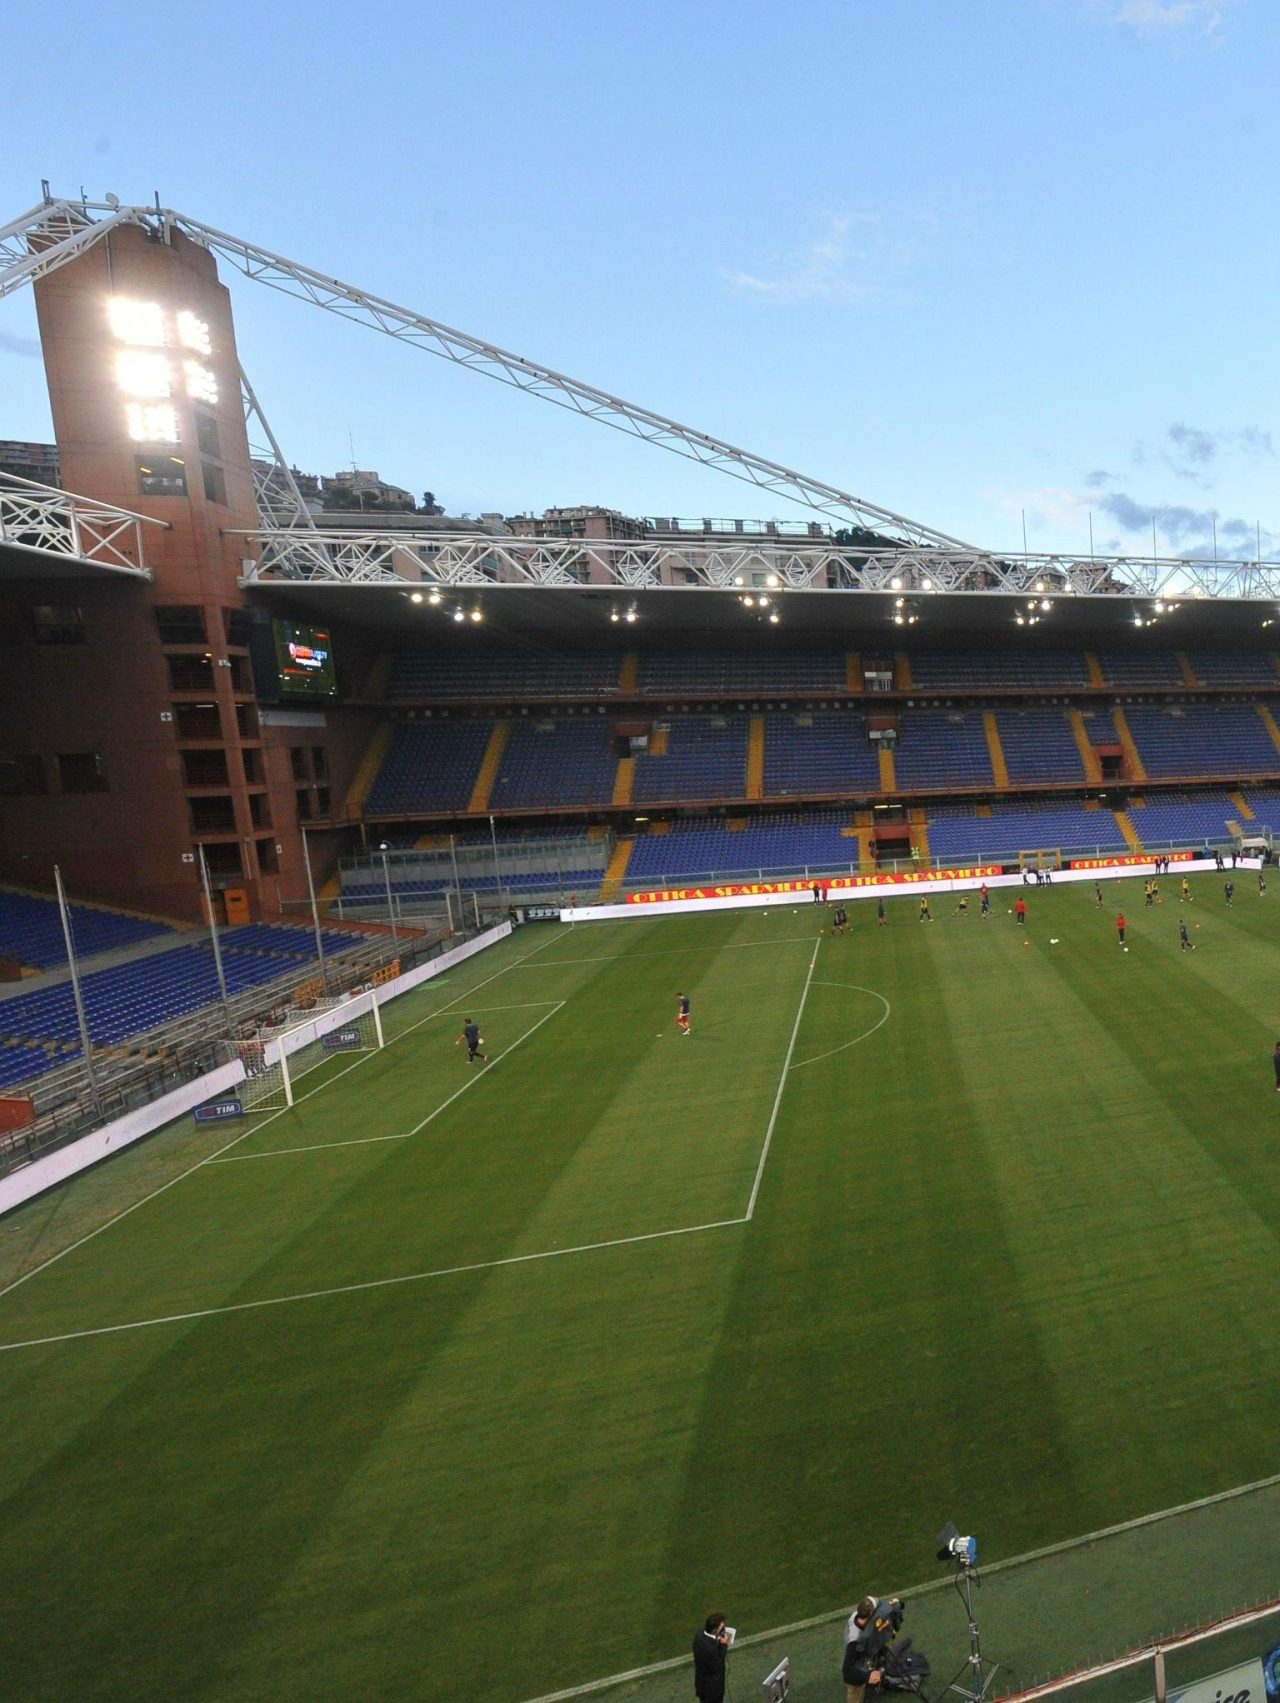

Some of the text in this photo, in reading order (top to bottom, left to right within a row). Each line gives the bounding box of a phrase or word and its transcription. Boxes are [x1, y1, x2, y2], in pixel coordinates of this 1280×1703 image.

[830, 867, 998, 888] OTTICA SPARVIERO
[633, 888, 706, 904] OTTICA
[216, 1104, 236, 1115] TIM
